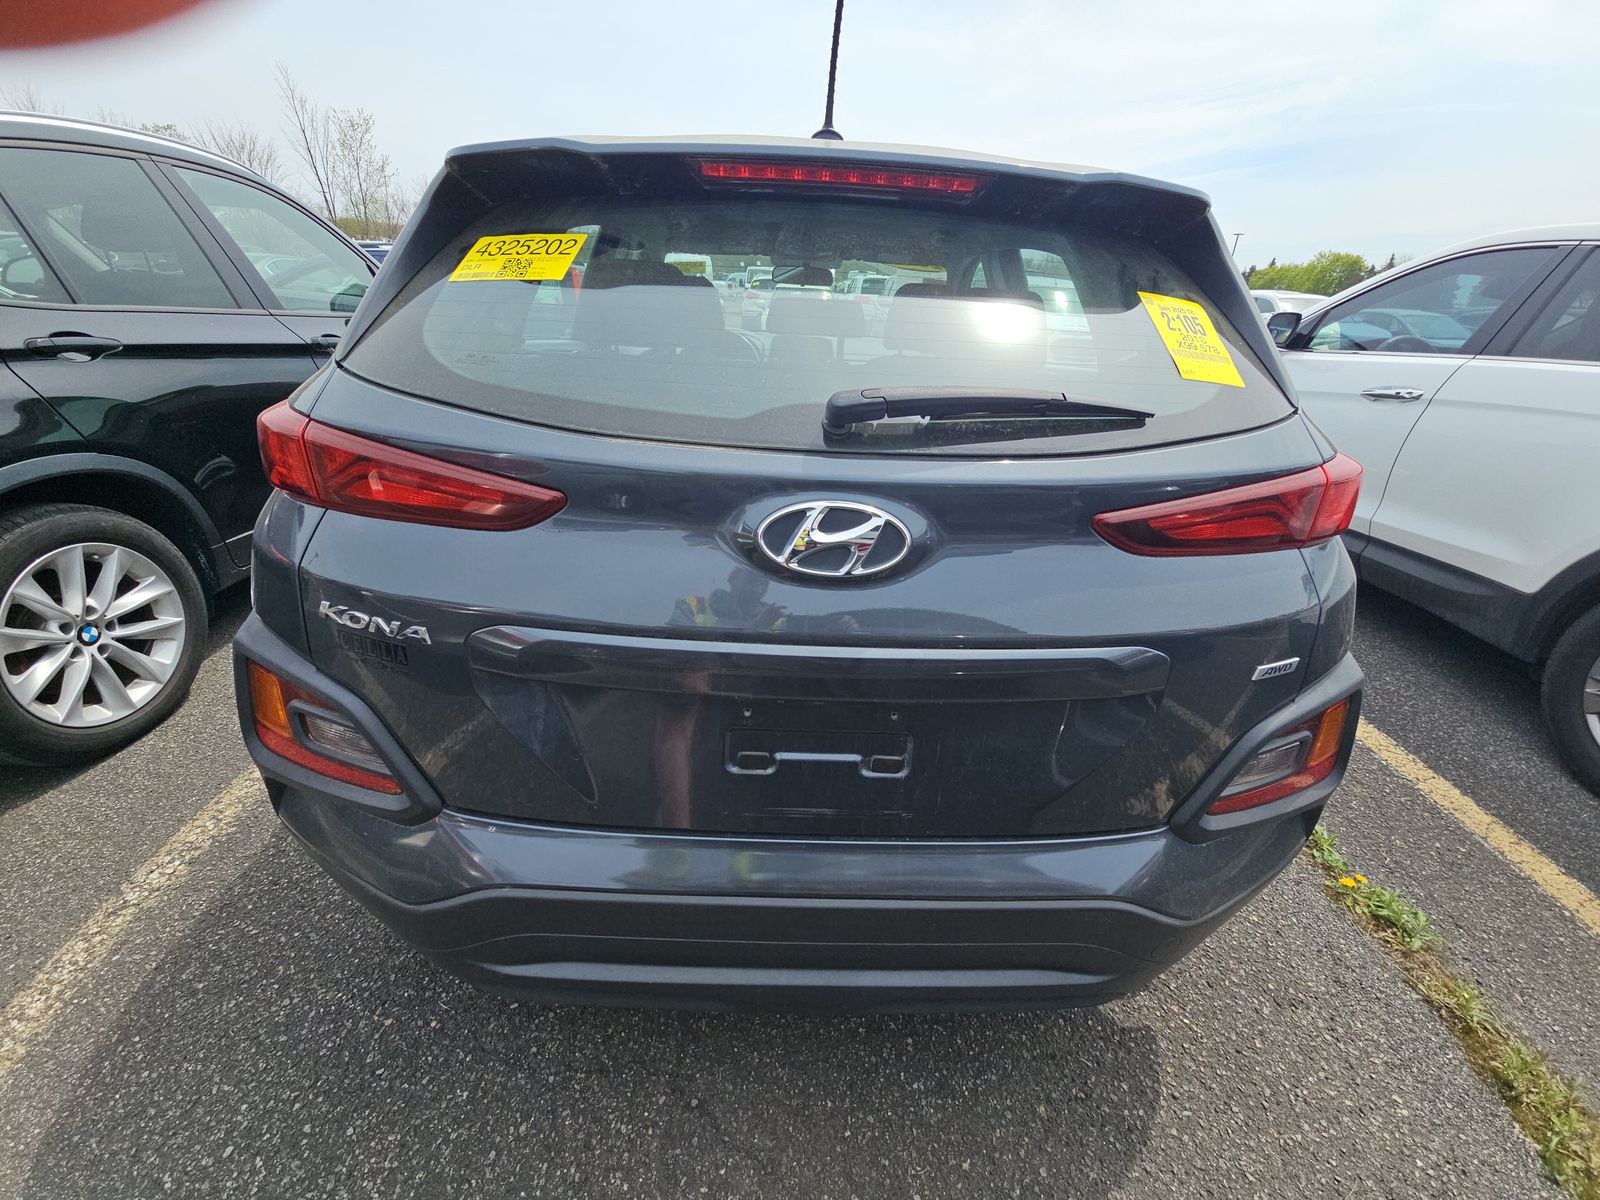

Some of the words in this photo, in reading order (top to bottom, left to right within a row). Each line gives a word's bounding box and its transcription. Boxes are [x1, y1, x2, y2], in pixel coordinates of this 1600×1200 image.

[476, 238, 577, 257] 4325202
[461, 263, 482, 271] DLR
[1162, 312, 1206, 336] 2:105
[319, 601, 432, 645] KONA
[1262, 663, 1292, 676] AWD
